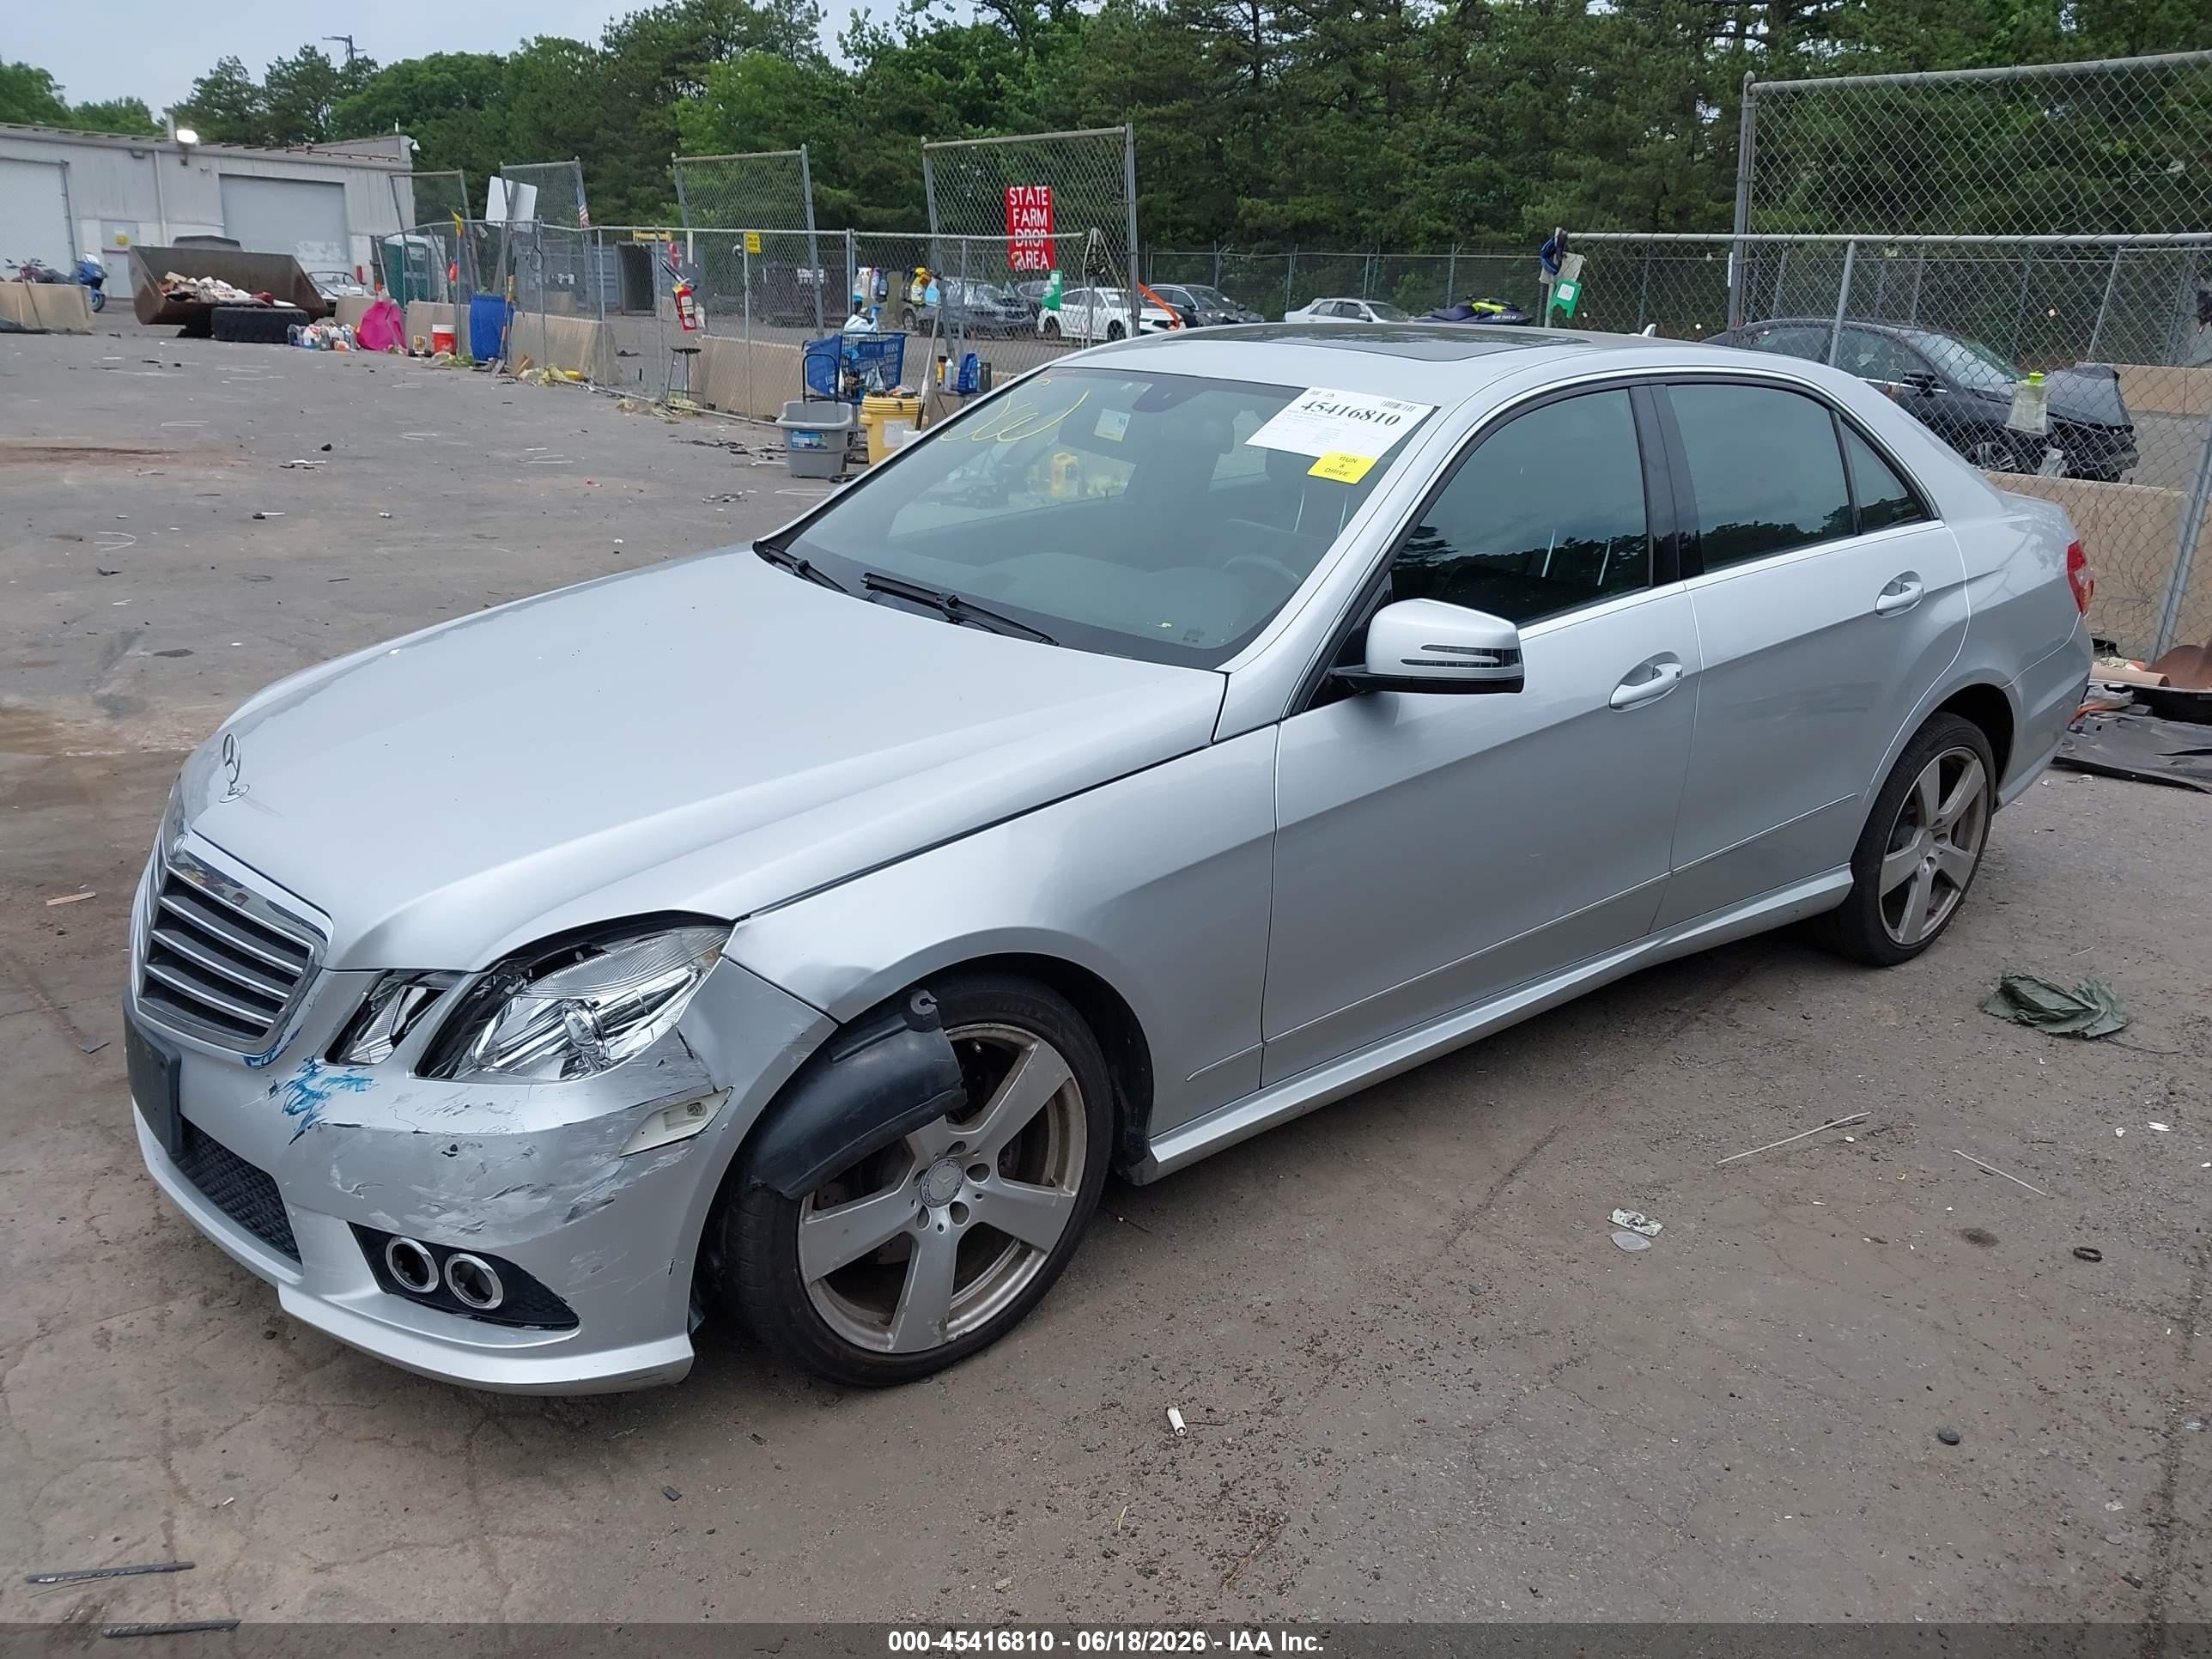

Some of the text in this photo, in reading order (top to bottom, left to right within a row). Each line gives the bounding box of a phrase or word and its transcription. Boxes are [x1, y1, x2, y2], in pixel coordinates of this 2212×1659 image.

[1009, 185, 1048, 206] STATE
[1012, 207, 1048, 228] FARM
[1014, 228, 1048, 248] DROP
[1301, 399, 1401, 427] 45416810
[1323, 467, 1351, 477] DRIVE
